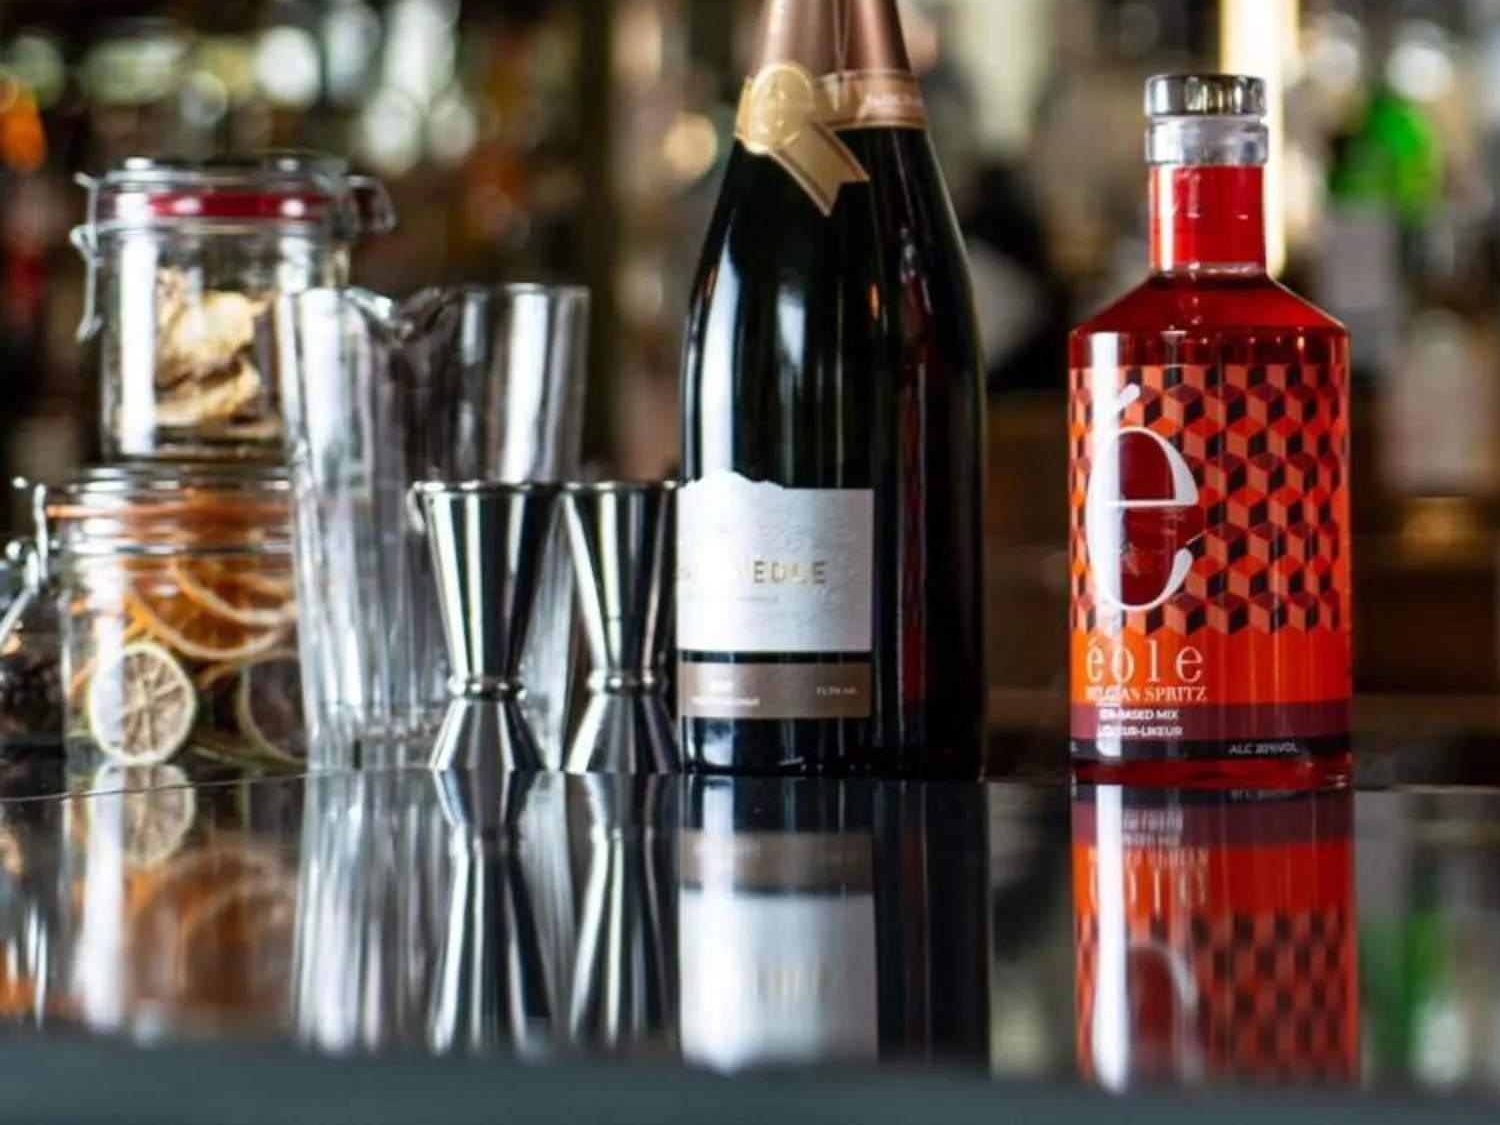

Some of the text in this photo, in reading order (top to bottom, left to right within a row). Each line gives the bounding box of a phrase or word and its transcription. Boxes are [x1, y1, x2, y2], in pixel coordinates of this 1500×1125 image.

[1086, 638, 1204, 684] éole
[1145, 685, 1207, 701] SPRITZ
[1157, 708, 1179, 720] MIX
